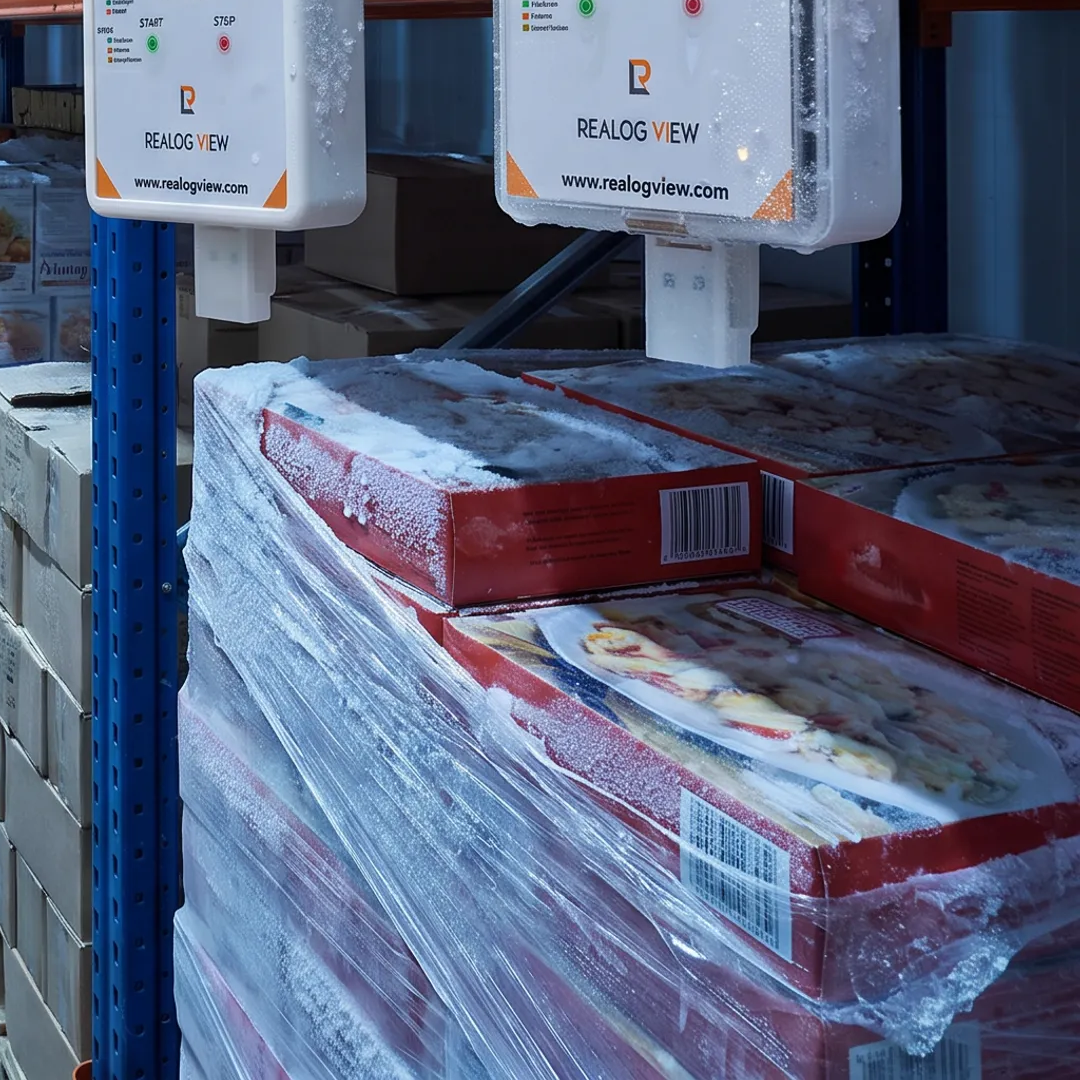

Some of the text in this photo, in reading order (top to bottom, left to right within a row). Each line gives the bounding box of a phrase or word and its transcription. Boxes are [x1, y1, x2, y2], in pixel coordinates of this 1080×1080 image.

[145, 131, 229, 152] REALOG VIEW
[577, 117, 700, 145] REALOG VIEW
[134, 176, 249, 196] www.realogview.com
[561, 174, 729, 201] www.realogview.com
